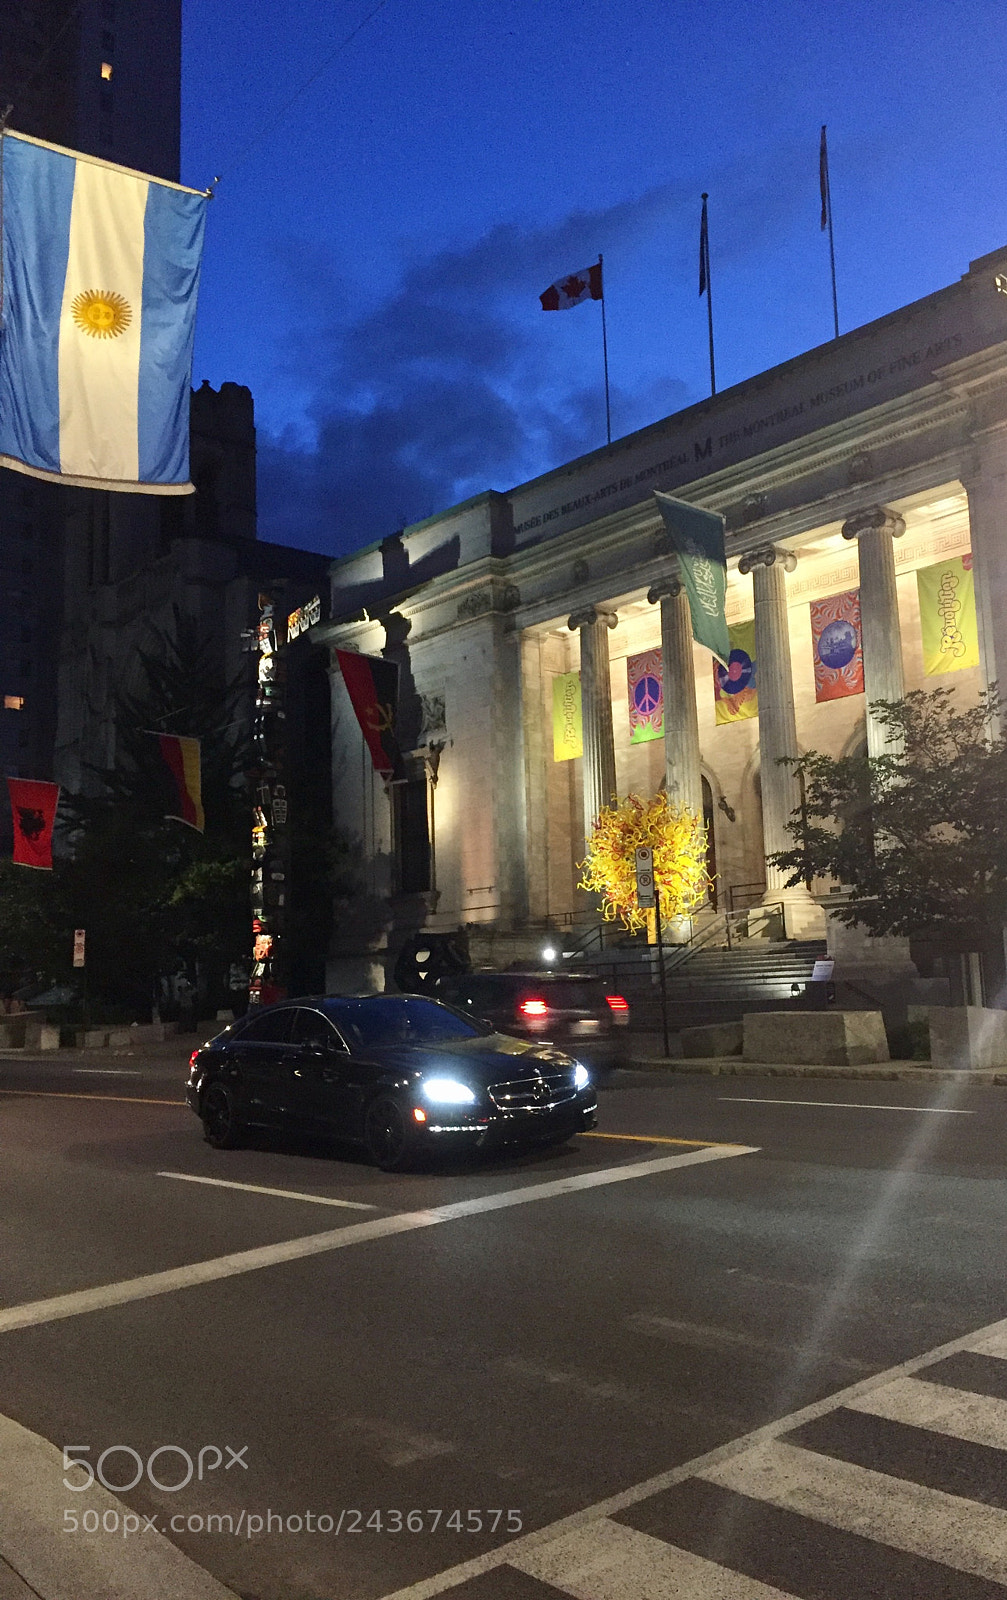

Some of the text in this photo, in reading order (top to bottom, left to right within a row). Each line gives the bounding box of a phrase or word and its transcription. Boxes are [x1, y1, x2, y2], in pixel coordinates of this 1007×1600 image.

[718, 430, 741, 448] THE
[810, 374, 865, 408] MUSEUM
[867, 368, 883, 384] OF
[889, 351, 922, 374] FINE
[694, 436, 713, 462] M
[514, 515, 542, 534] MUSÉE
[543, 506, 560, 523] DES
[561, 485, 619, 516] BEAUX-ARTS
[620, 476, 633, 492] DE
